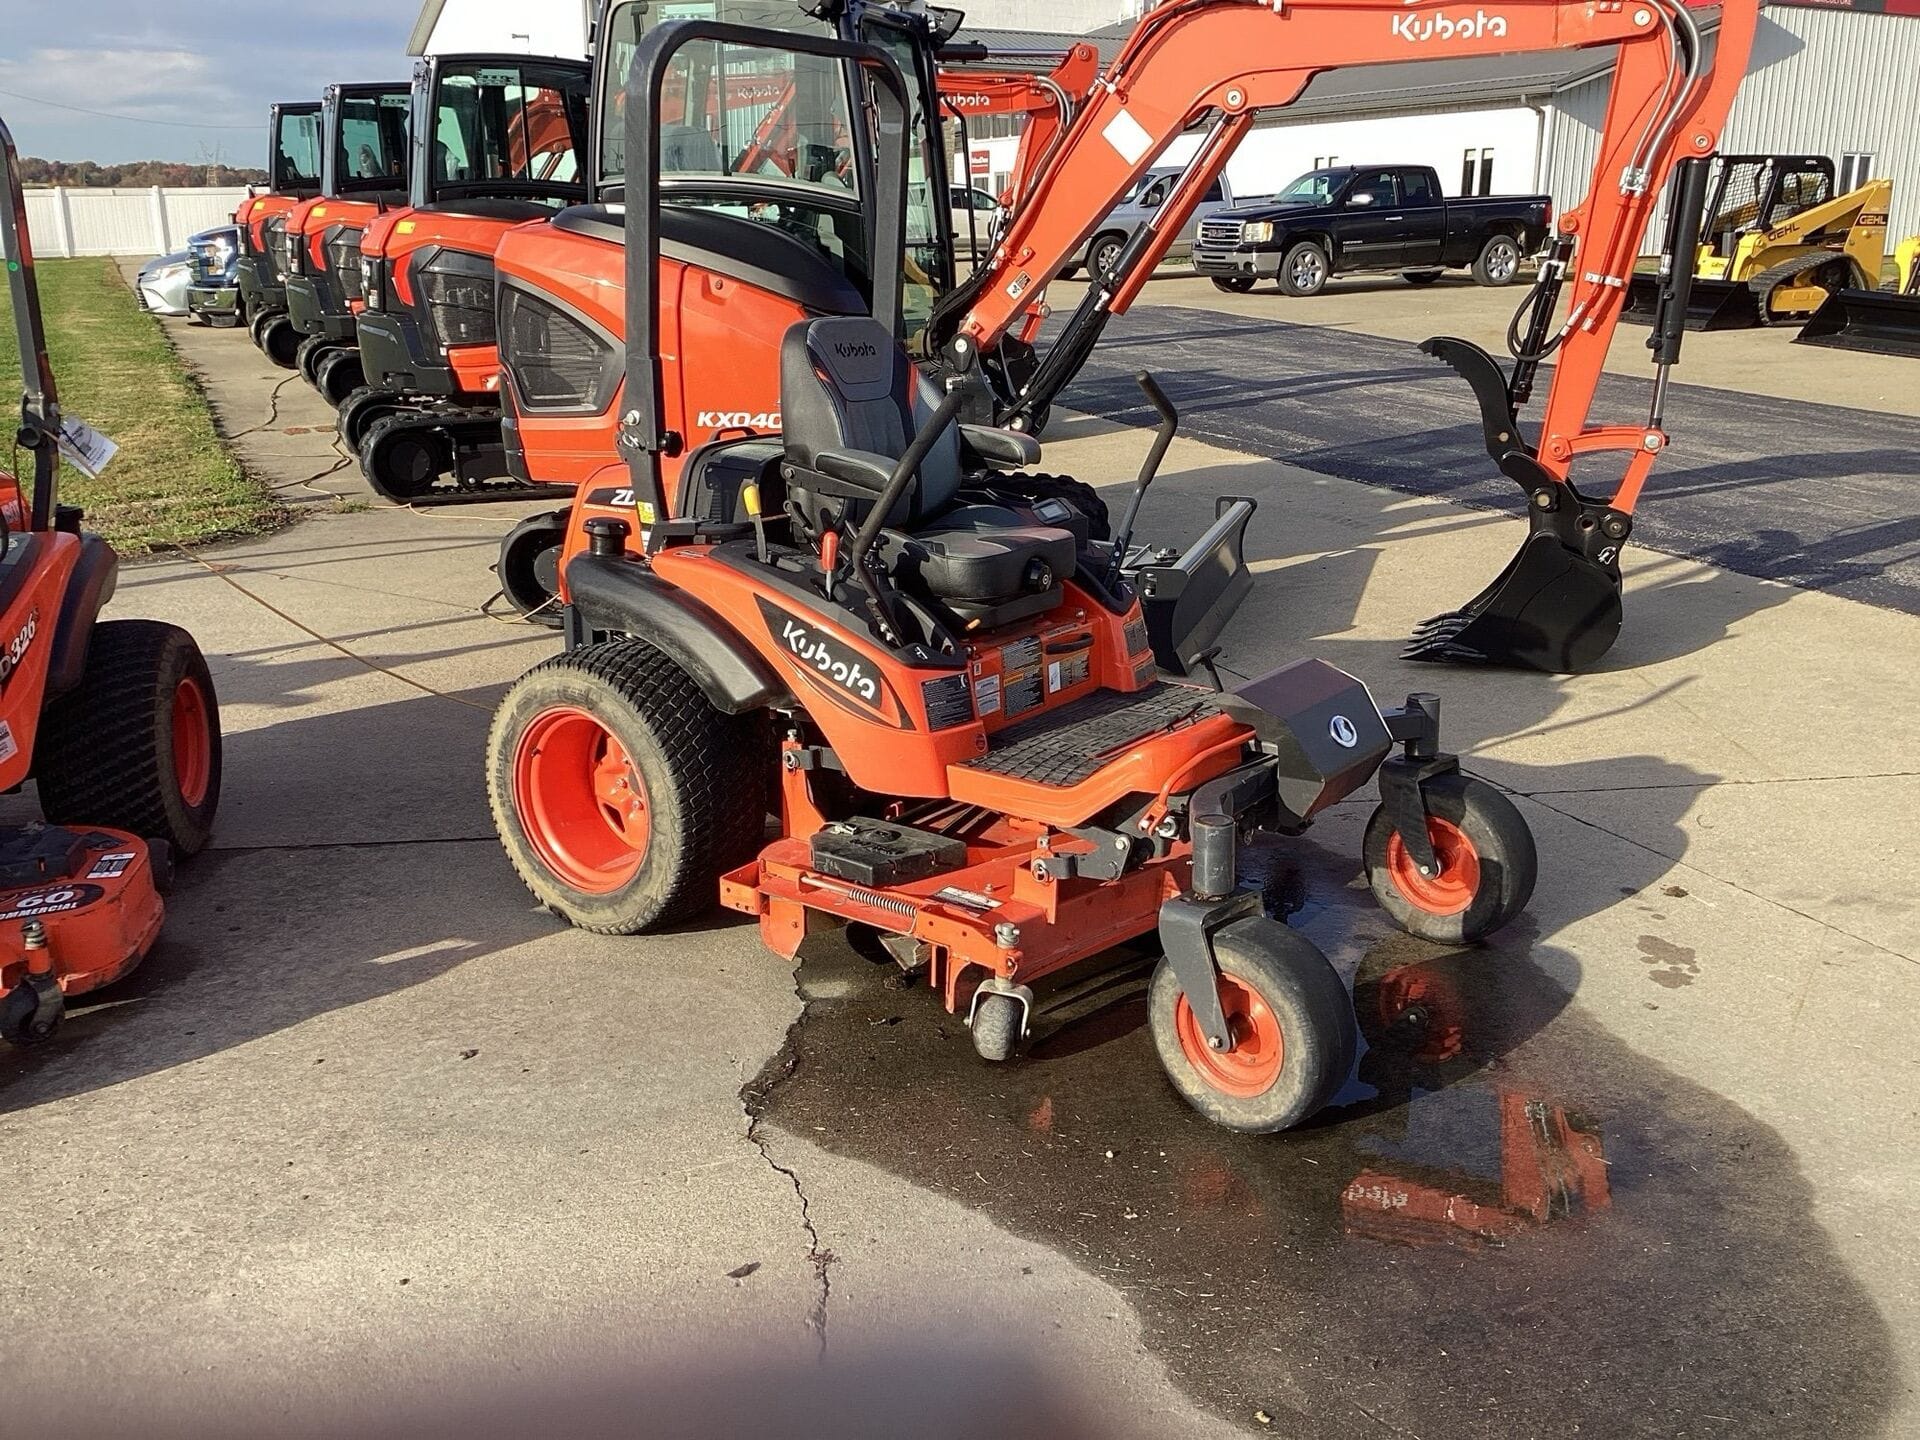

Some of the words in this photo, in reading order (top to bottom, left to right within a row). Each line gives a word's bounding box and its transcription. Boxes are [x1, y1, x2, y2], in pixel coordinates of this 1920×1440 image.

[1392, 10, 1507, 41] Kubota
[737, 84, 780, 99] Kubota
[1859, 214, 1887, 225] GEHL
[1767, 222, 1801, 242] GEHL
[834, 341, 876, 358] Kubota
[783, 620, 876, 700] Kubota
[16, 890, 75, 908] 60
